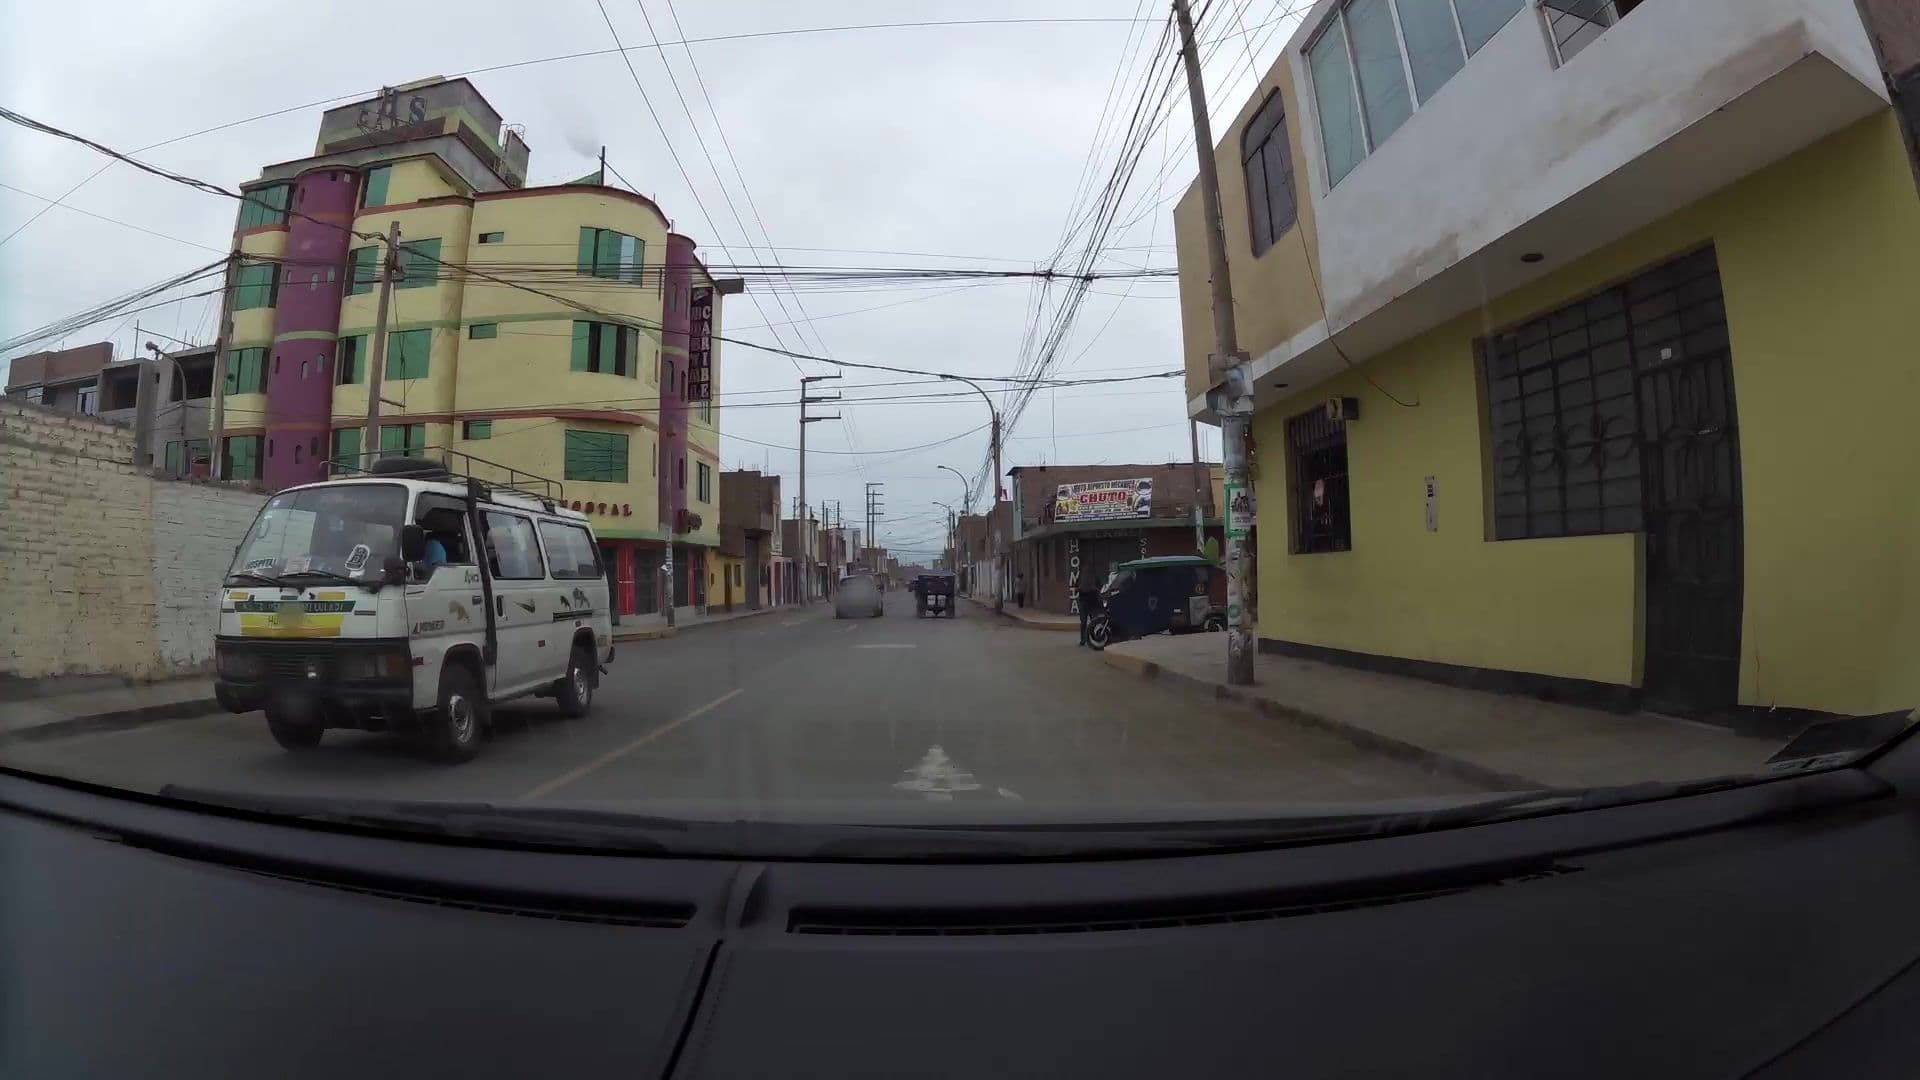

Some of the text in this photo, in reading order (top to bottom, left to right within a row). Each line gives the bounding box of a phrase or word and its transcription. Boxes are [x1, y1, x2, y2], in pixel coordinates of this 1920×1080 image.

[701, 305, 711, 400] CARIBE
[559, 499, 632, 517] HOSTAL
[1080, 491, 1127, 504] CHUTO
[1068, 538, 1080, 613] HONDA
